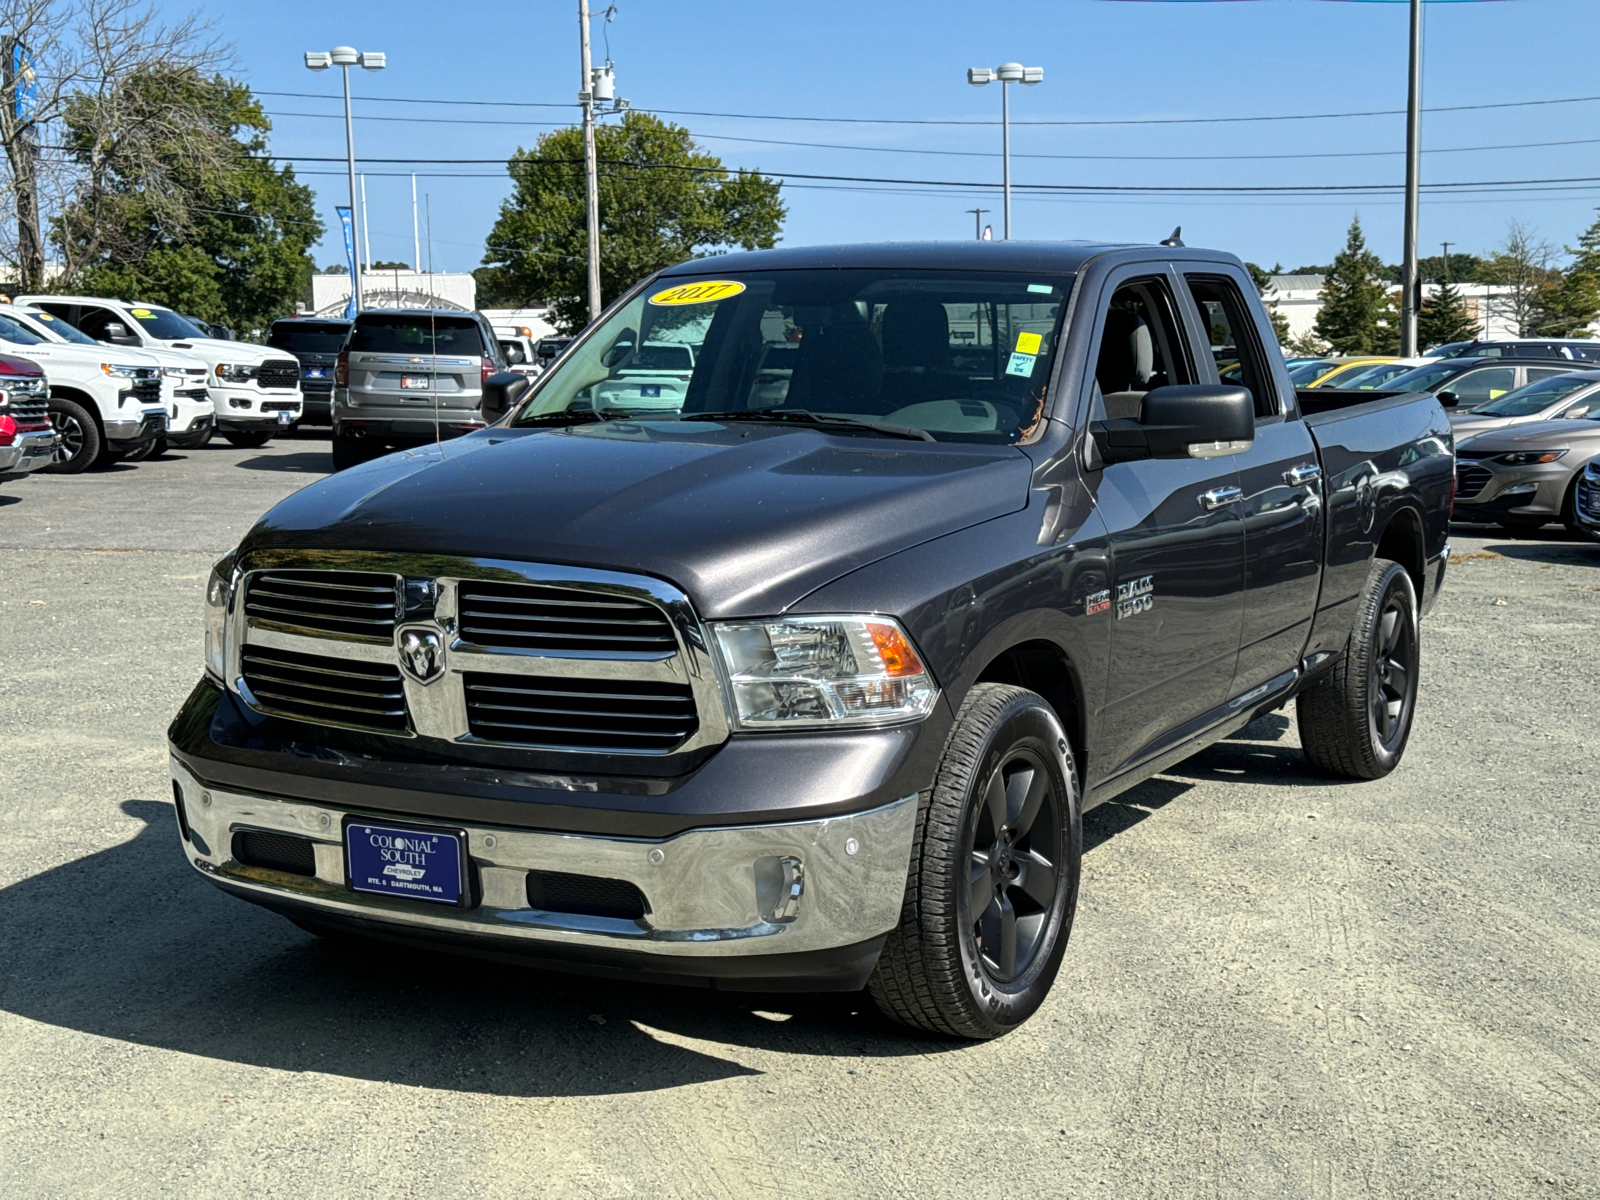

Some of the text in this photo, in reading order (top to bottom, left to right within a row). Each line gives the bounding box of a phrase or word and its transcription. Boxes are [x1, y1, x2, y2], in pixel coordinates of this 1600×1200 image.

[342, 286, 408, 302] DTMOUTH
[658, 284, 734, 302] 2017
[1012, 354, 1033, 363] SAFETY
[1116, 574, 1154, 602] RAM
[1116, 593, 1153, 620] 1500
[369, 834, 436, 854] COLONIAL
[380, 849, 426, 865] SOUTH
[386, 867, 422, 877] CHEVROLET
[367, 877, 381, 885] RTE.
[391, 880, 432, 893] DARTMOUTH,
[432, 885, 443, 893] MA
